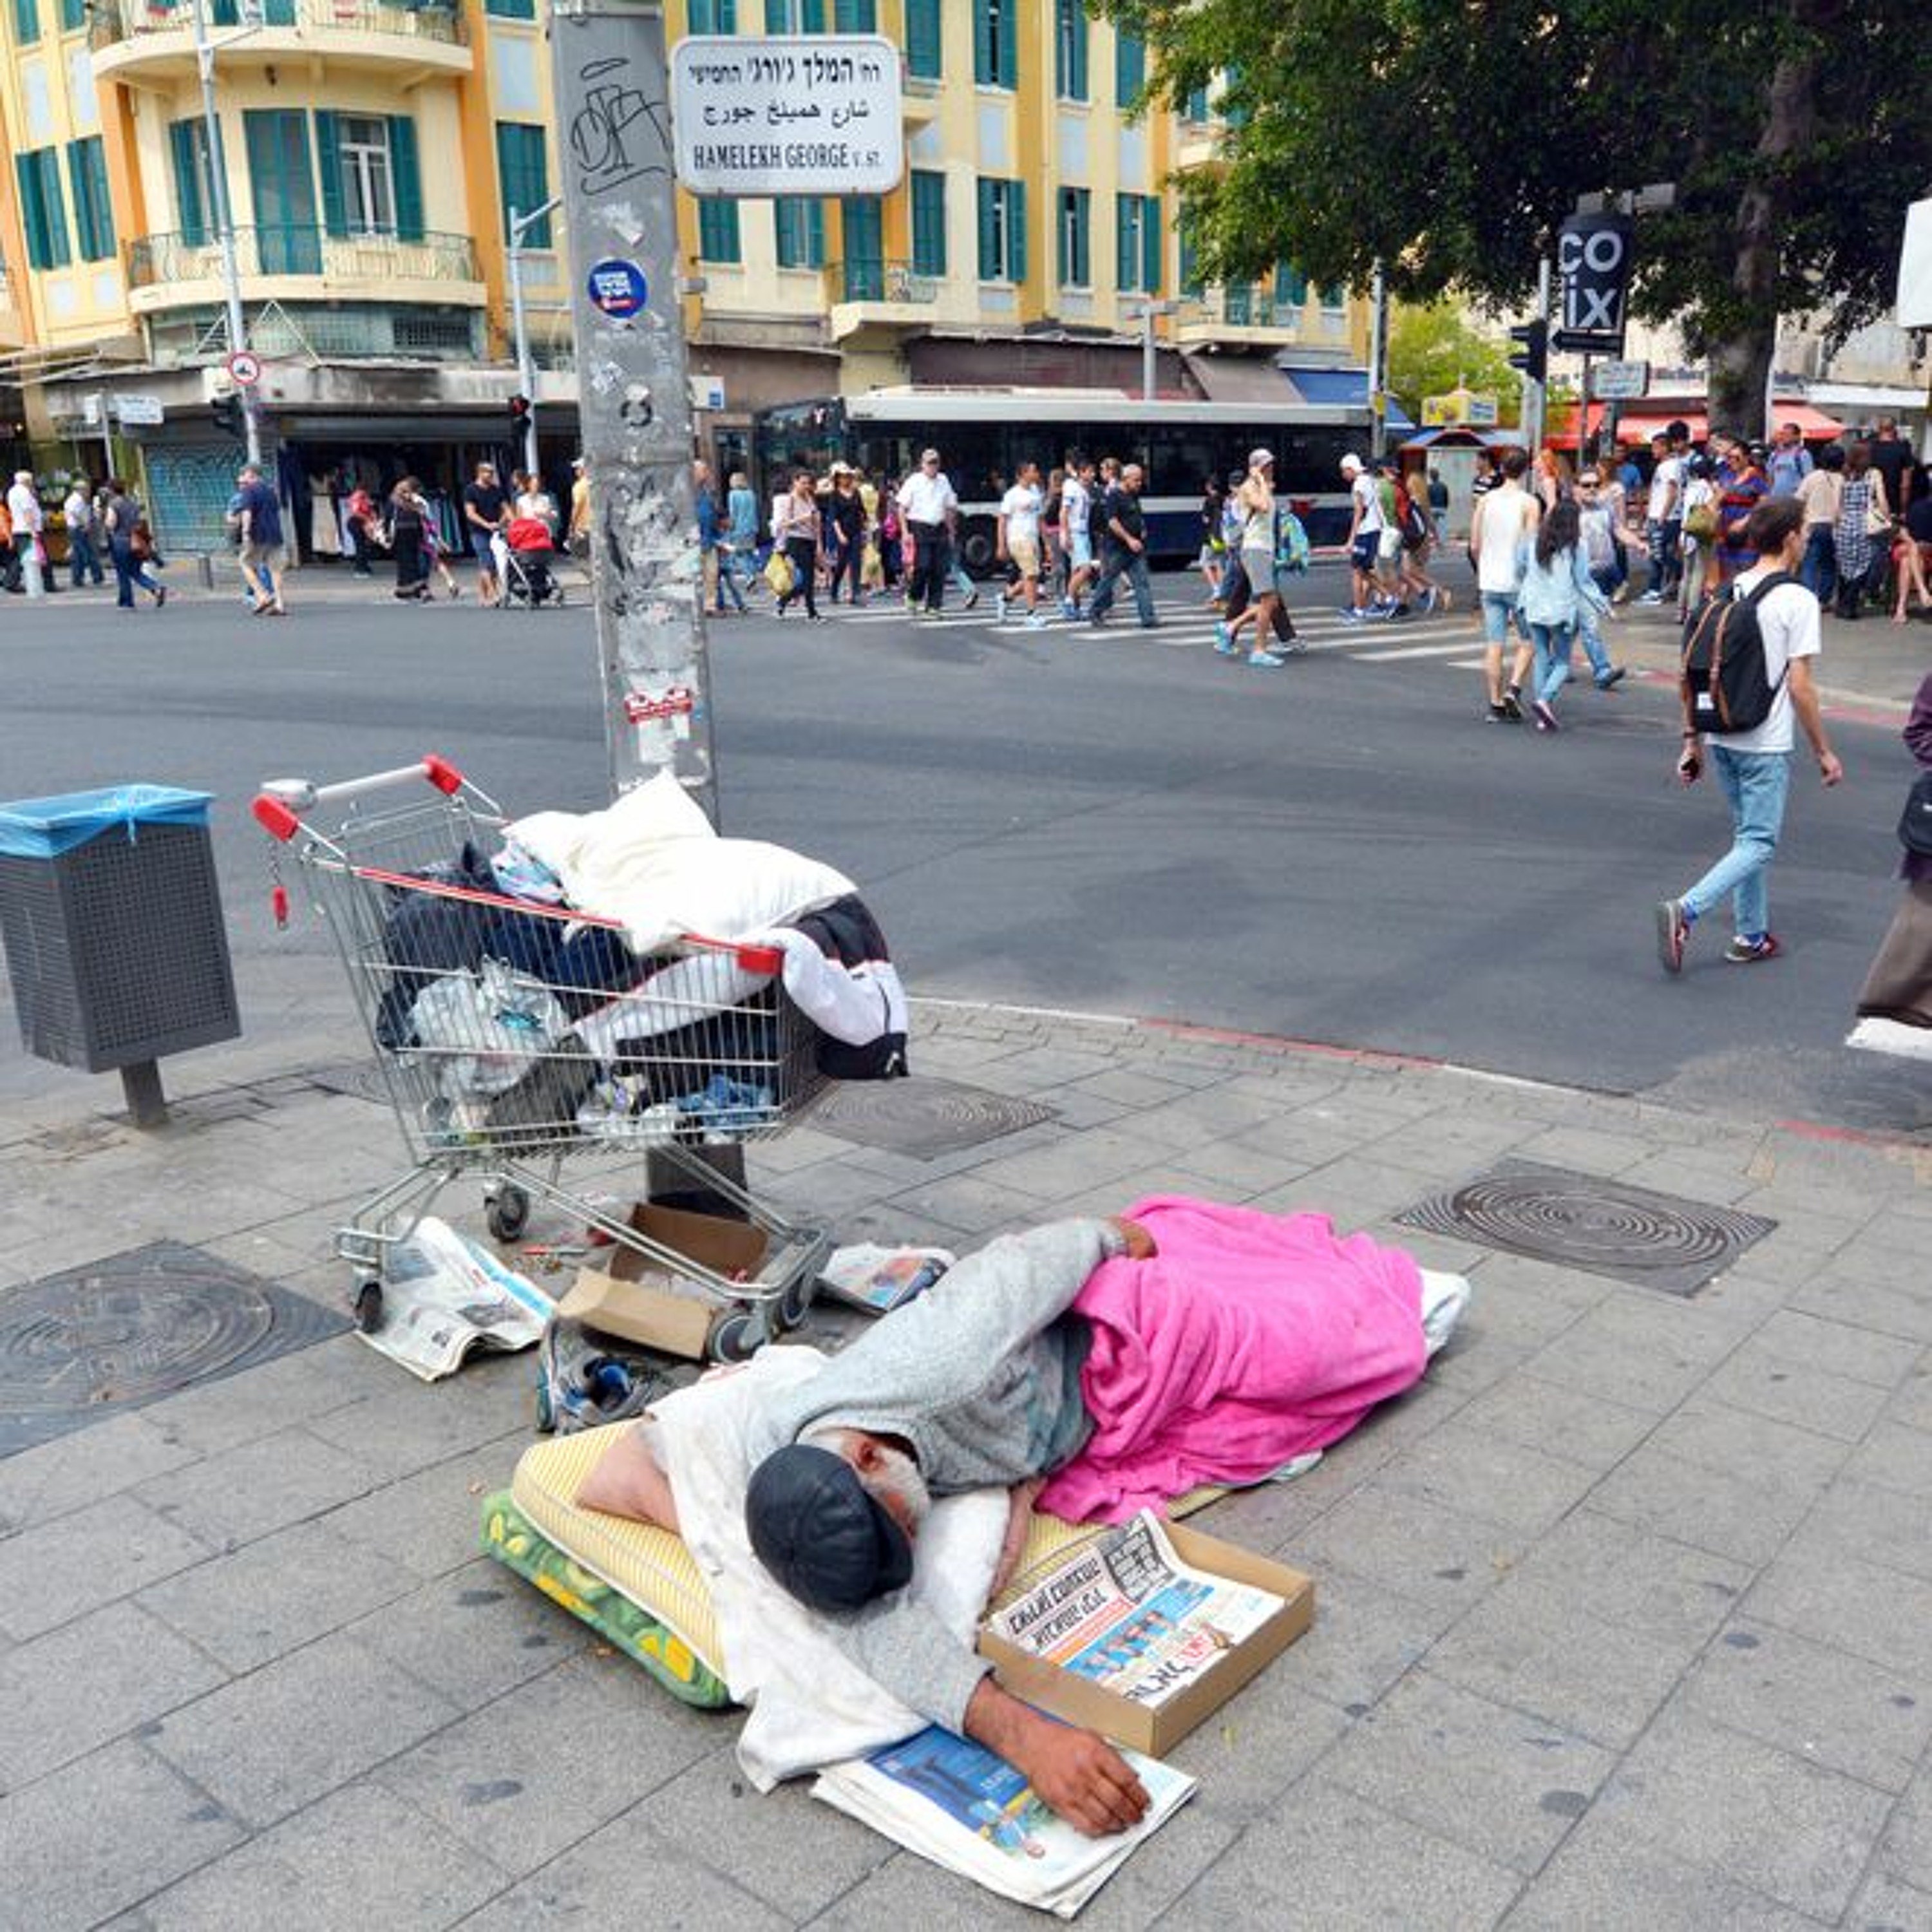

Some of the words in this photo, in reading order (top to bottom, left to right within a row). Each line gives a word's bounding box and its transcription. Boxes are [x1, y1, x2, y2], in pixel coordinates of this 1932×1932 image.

[802, 51, 853, 90] המלך
[703, 104, 756, 126] جورج
[831, 99, 870, 129] شارع
[694, 144, 782, 171] HAMELEKH
[784, 142, 849, 169] GEORGE
